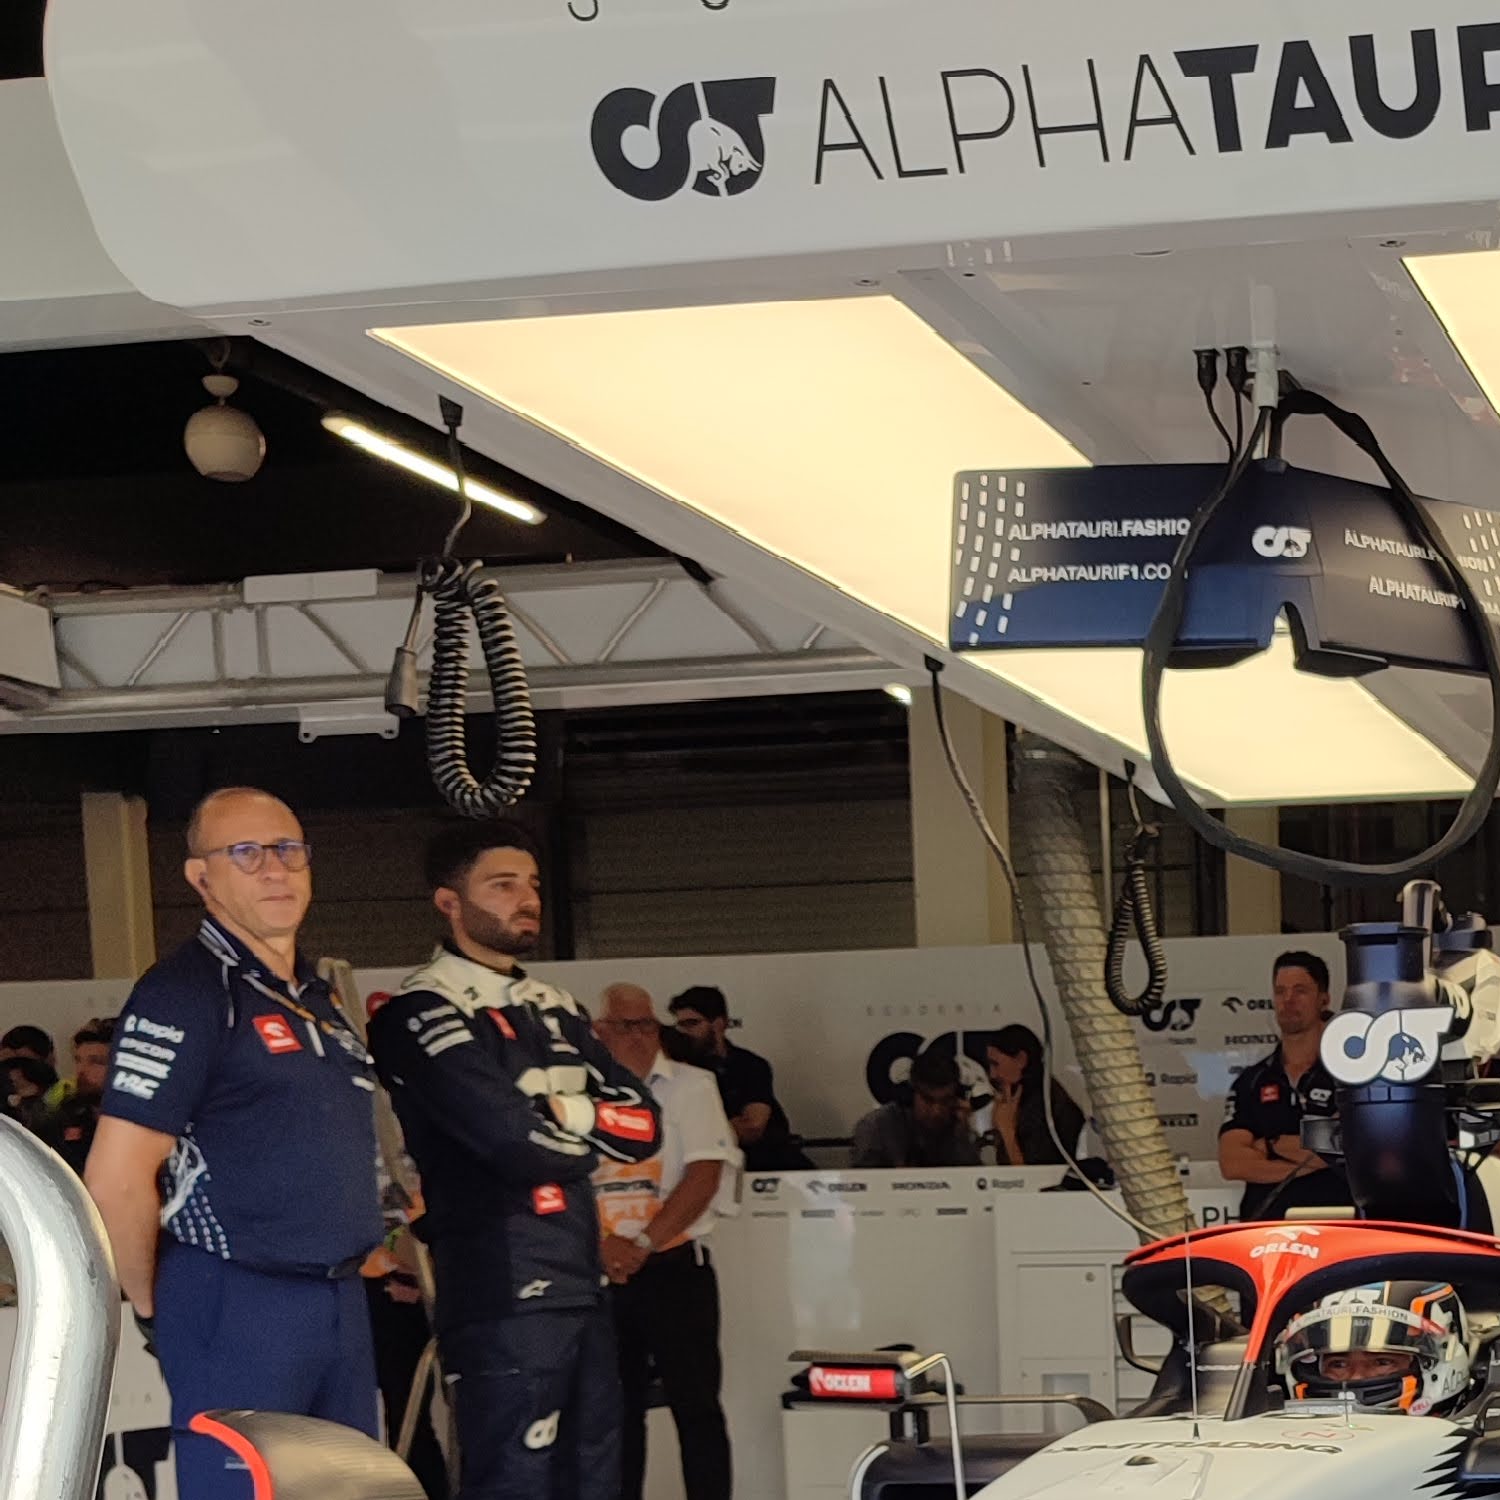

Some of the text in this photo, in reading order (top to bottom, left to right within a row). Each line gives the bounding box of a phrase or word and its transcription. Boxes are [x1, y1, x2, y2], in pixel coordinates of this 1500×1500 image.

[1008, 517, 1190, 541] ALPHATAURI.FASHIO
[1225, 1034, 1280, 1046] HOND
[1250, 1241, 1319, 1260] ORLEN
